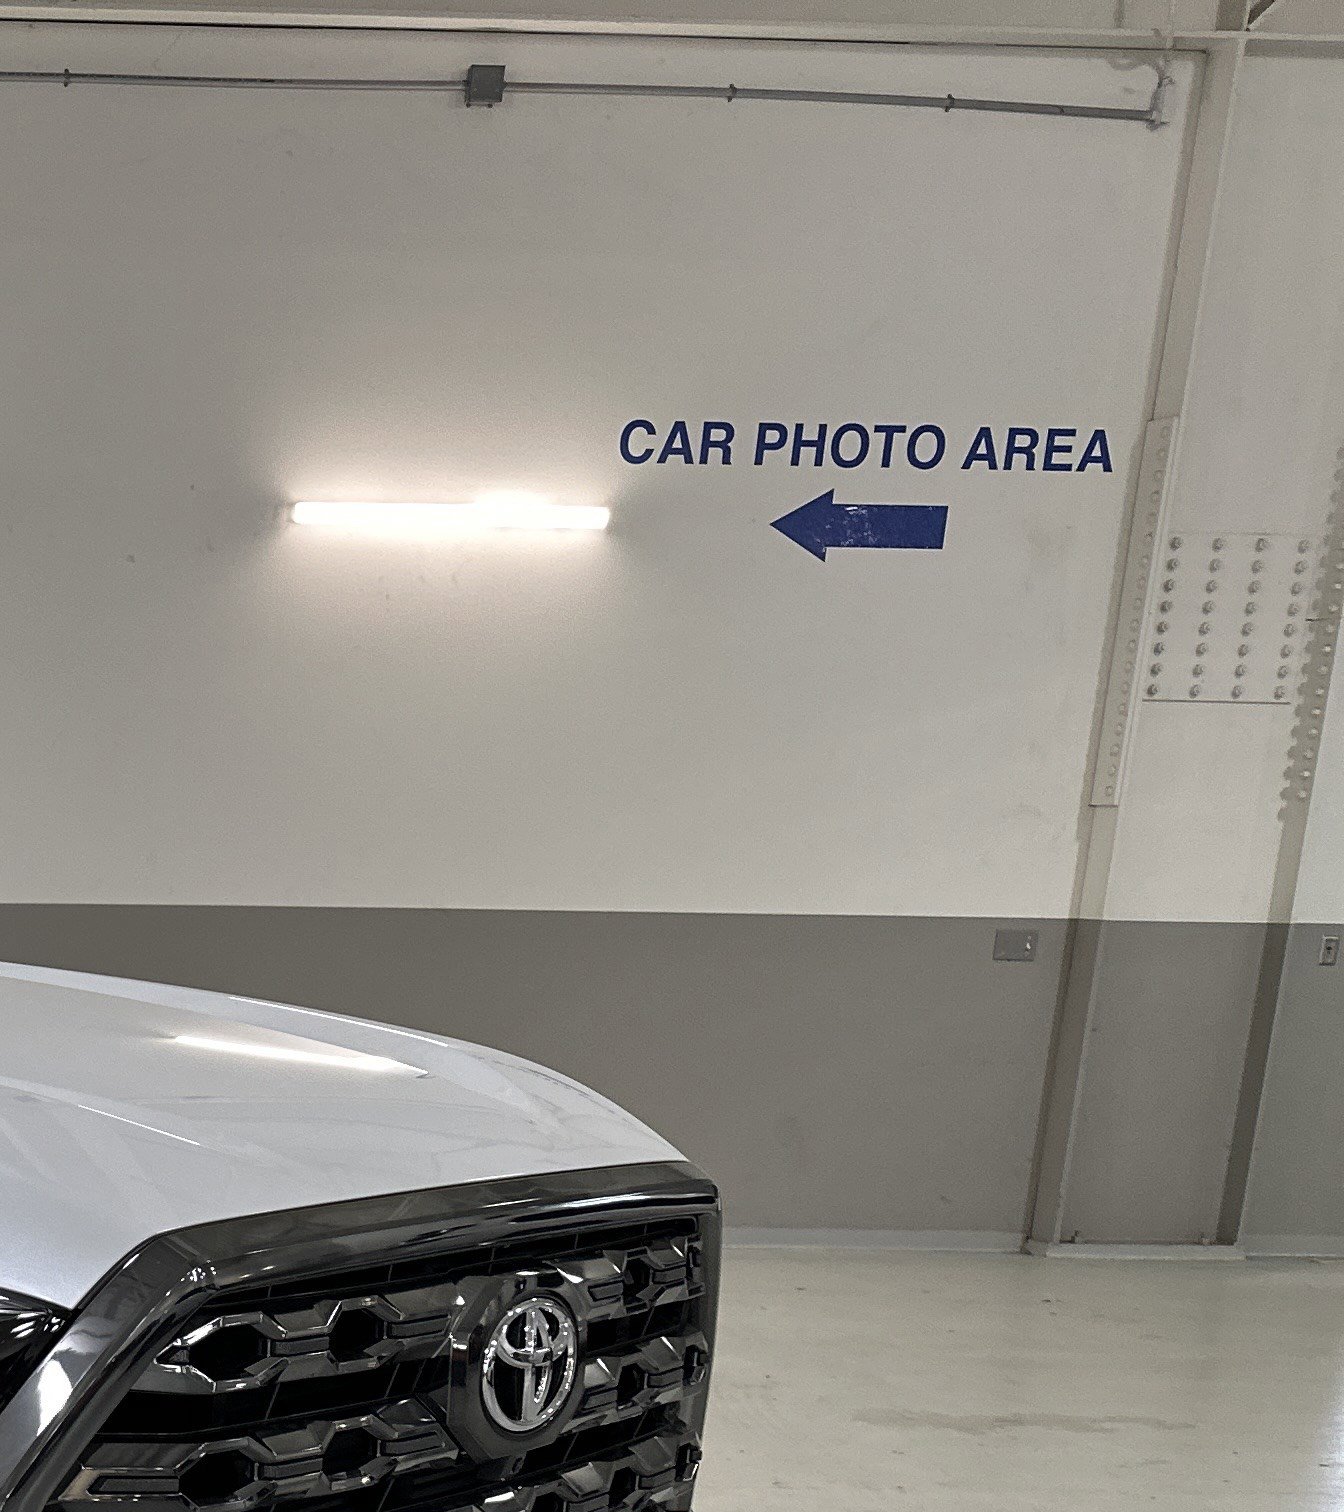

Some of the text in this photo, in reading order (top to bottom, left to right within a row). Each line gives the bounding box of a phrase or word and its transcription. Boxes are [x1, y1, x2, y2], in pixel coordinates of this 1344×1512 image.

[618, 419, 1113, 473] CAR PHOTO AREA
